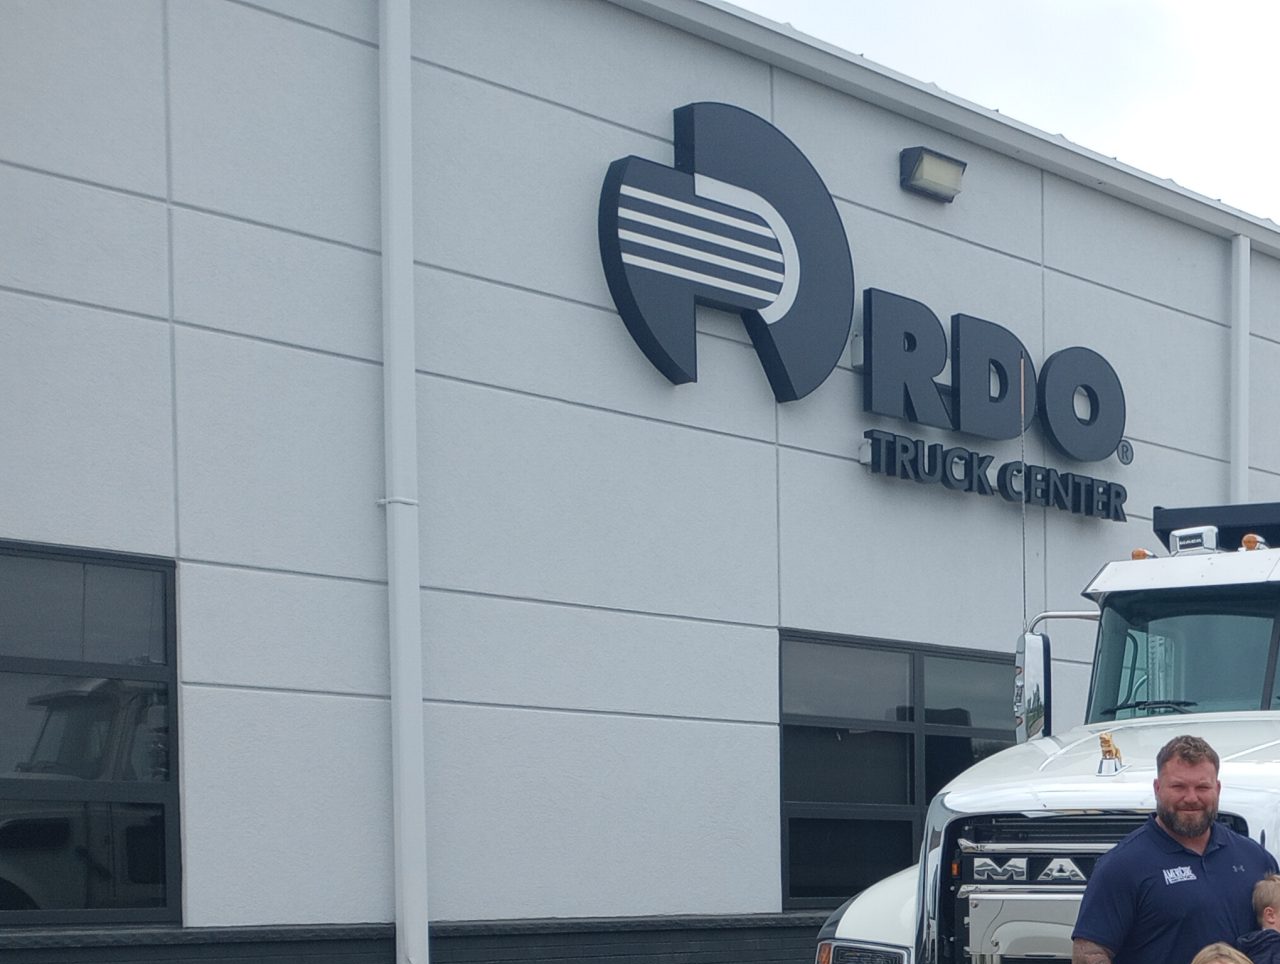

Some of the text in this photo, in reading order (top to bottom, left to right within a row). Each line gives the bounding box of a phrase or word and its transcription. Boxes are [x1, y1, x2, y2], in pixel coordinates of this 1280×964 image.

[863, 287, 1127, 463] RDO
[864, 429, 1127, 522] TRUCK CENTER
[973, 857, 1087, 881] MA
